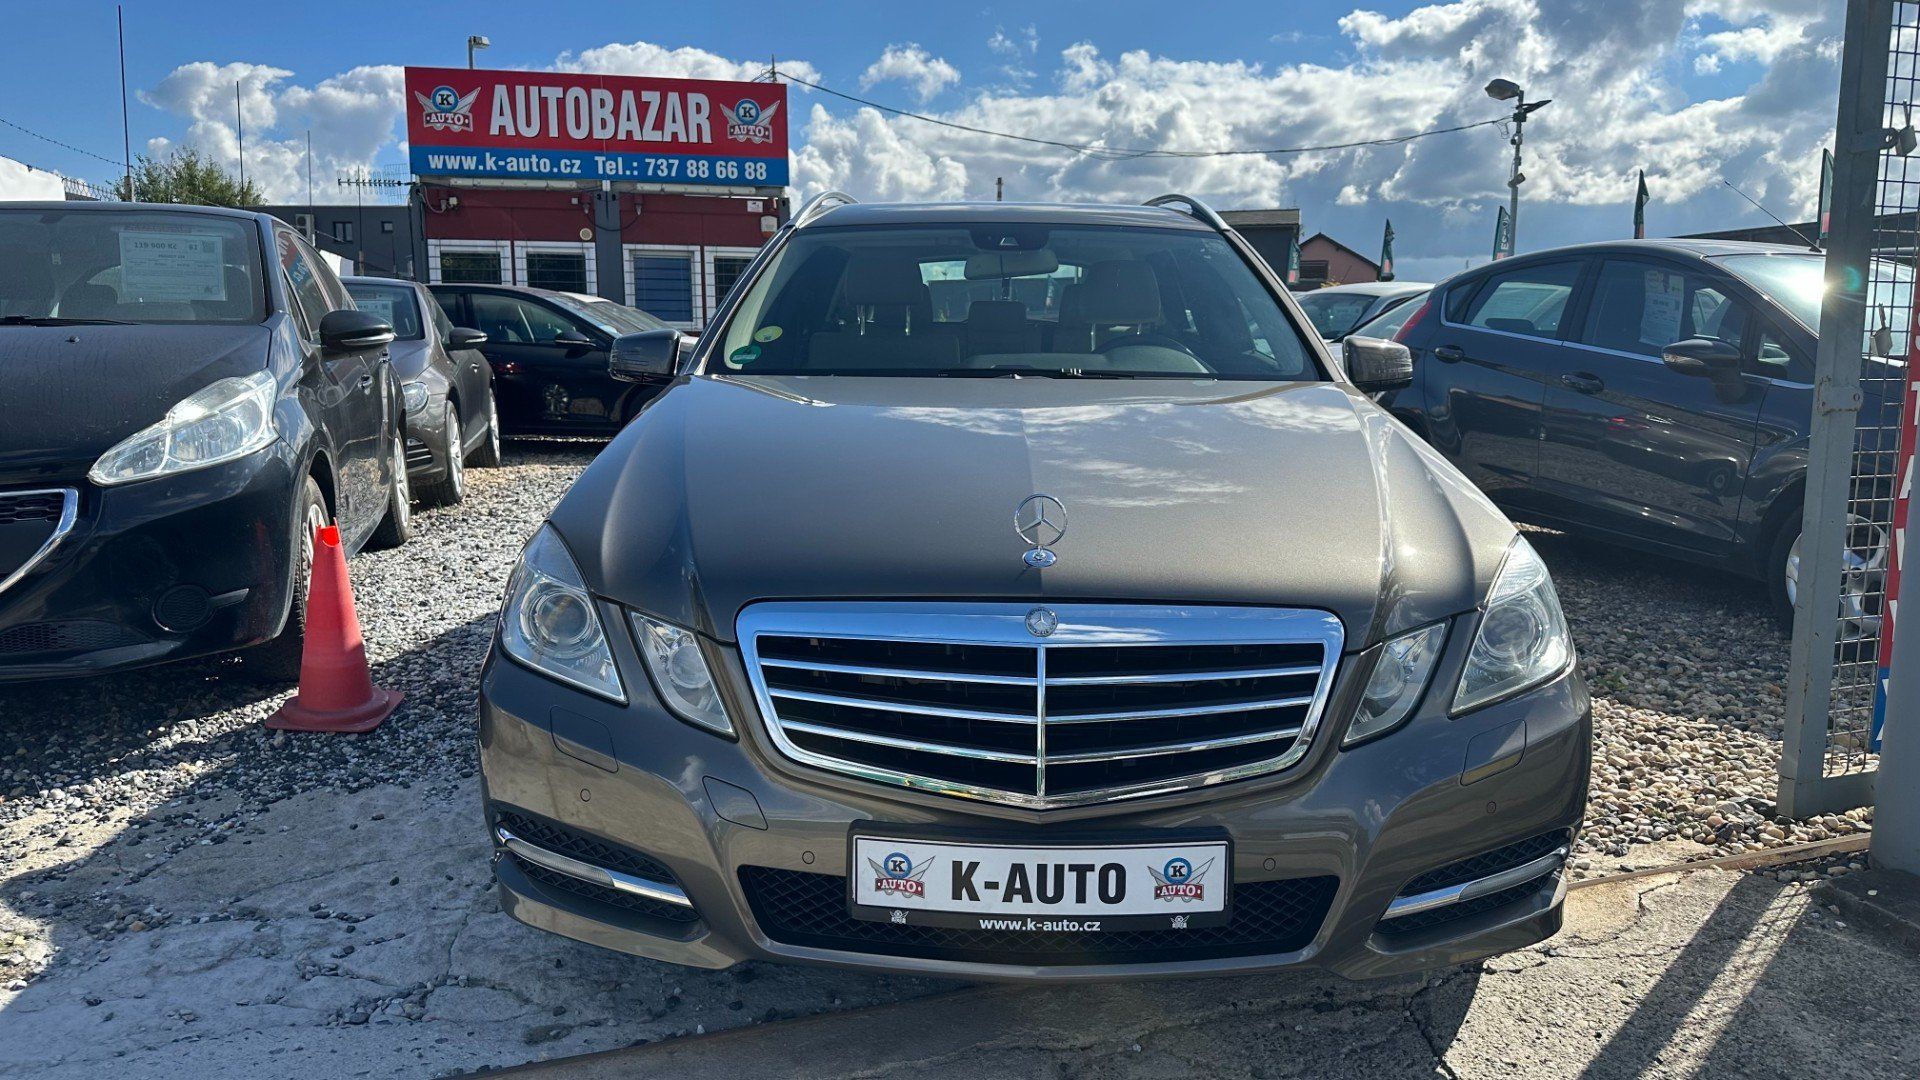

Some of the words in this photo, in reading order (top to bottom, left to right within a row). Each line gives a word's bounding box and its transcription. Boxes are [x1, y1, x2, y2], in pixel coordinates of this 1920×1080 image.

[439, 94, 452, 105] K
[489, 84, 712, 144] AUTOBAZAR
[742, 107, 754, 118] K
[430, 113, 464, 125] AUTO
[734, 125, 765, 137] AUTO
[428, 152, 581, 174] www.k-auto.cz
[594, 156, 638, 175] Tel.:
[645, 158, 679, 177] 737
[686, 159, 709, 178] 88
[715, 160, 738, 179] 66
[744, 162, 767, 180] 88
[151, 242, 166, 250] 900
[891, 860, 906, 872] K
[1171, 865, 1185, 877] K
[881, 879, 917, 892] AUTO
[952, 860, 1127, 905] K-AUTO
[1160, 884, 1196, 897] AUTO
[979, 918, 1101, 931] www.k-auto.cz
